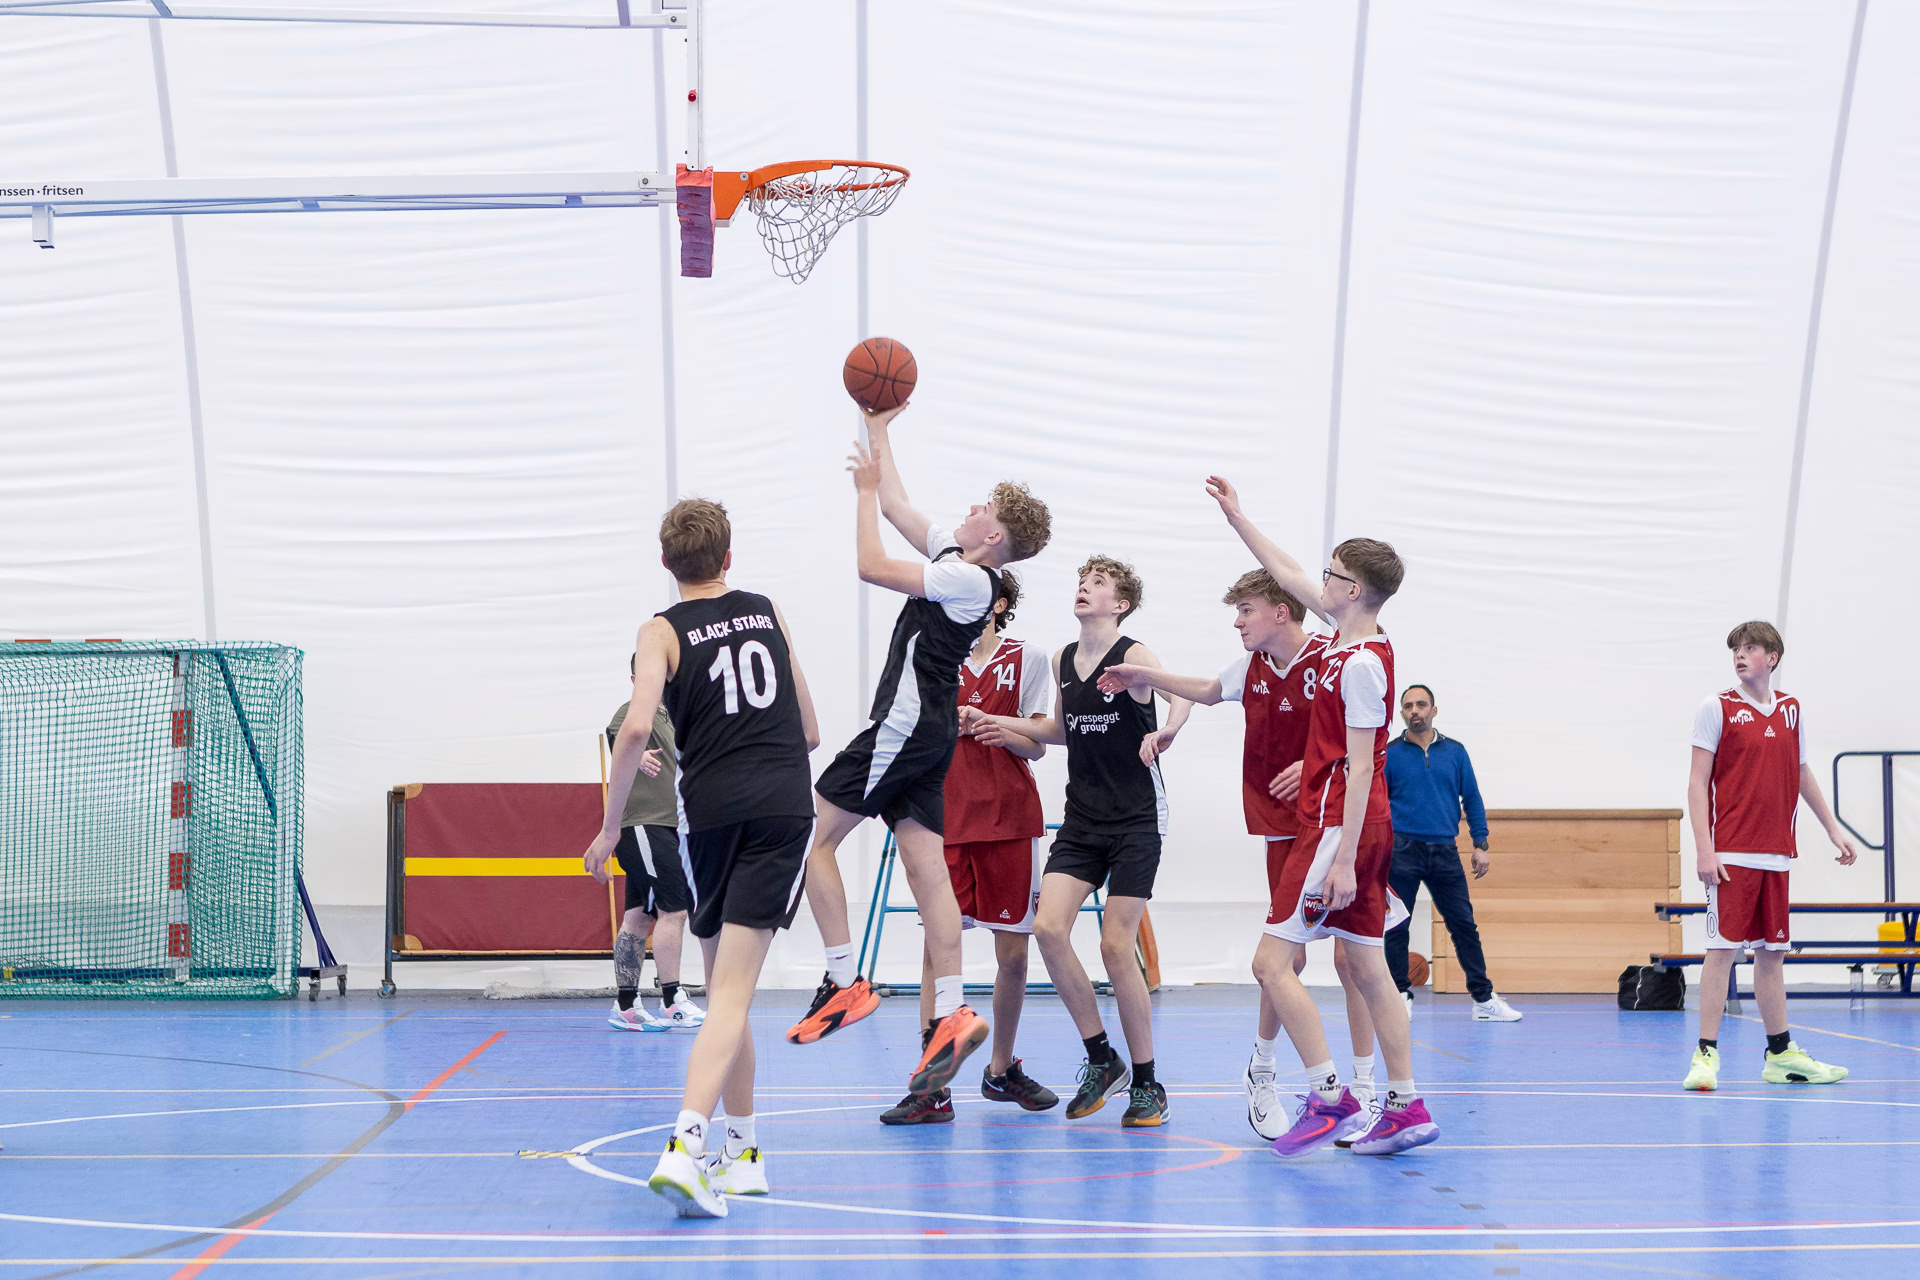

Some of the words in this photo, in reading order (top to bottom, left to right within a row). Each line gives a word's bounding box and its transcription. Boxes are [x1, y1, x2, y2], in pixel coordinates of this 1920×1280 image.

[687, 621, 733, 646] BLACK
[732, 615, 774, 631] STARS
[709, 640, 777, 714] 10
[992, 663, 1016, 691] 14
[1303, 667, 1317, 700] 8
[1320, 657, 1343, 693] 12
[1079, 711, 1120, 725] respeggt
[1080, 724, 1108, 735] group
[1780, 704, 1798, 730] 10
